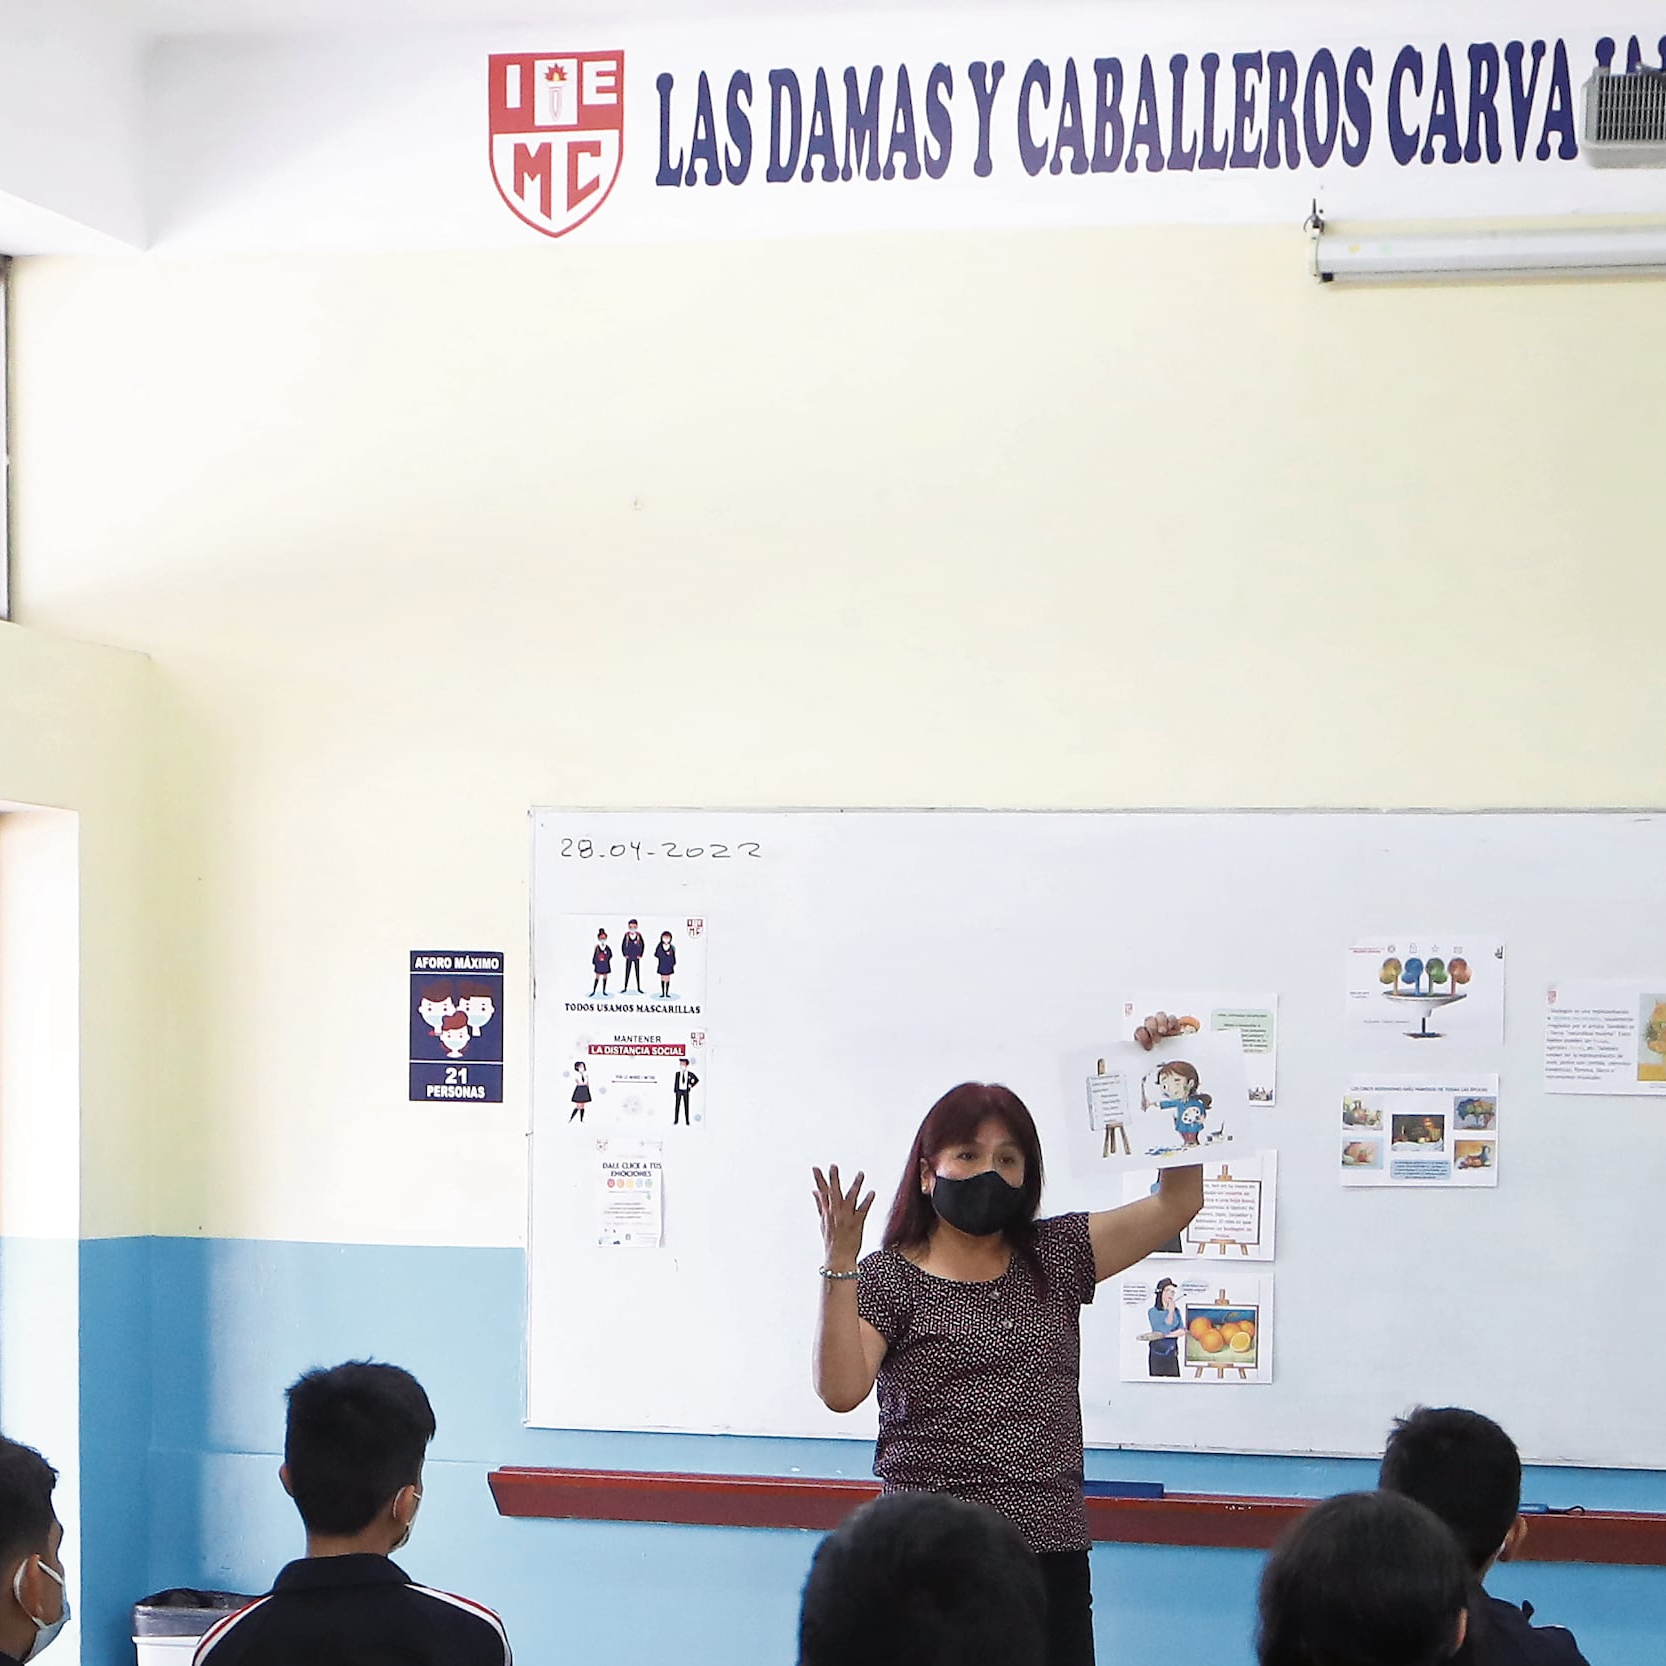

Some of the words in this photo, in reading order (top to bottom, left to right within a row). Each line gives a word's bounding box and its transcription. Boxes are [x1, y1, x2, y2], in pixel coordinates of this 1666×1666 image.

[655, 69, 752, 188] LAS
[765, 62, 953, 183] DAMAS
[967, 60, 1006, 179] Y
[1017, 46, 1374, 175] CABALLEROS
[414, 956, 452, 970] AFORO
[454, 954, 501, 971] MÁXIMO
[564, 1001, 595, 1012] TODOS
[596, 1002, 635, 1013] USAMOS
[636, 1003, 702, 1015] MASCARILLAS
[613, 1034, 662, 1044] MANTENER
[590, 1045, 603, 1055] LA
[604, 1045, 651, 1056] DISTANCIA
[651, 1046, 685, 1056] SOCIAL
[444, 1066, 469, 1085] 21
[426, 1084, 486, 1100] PERSONAS
